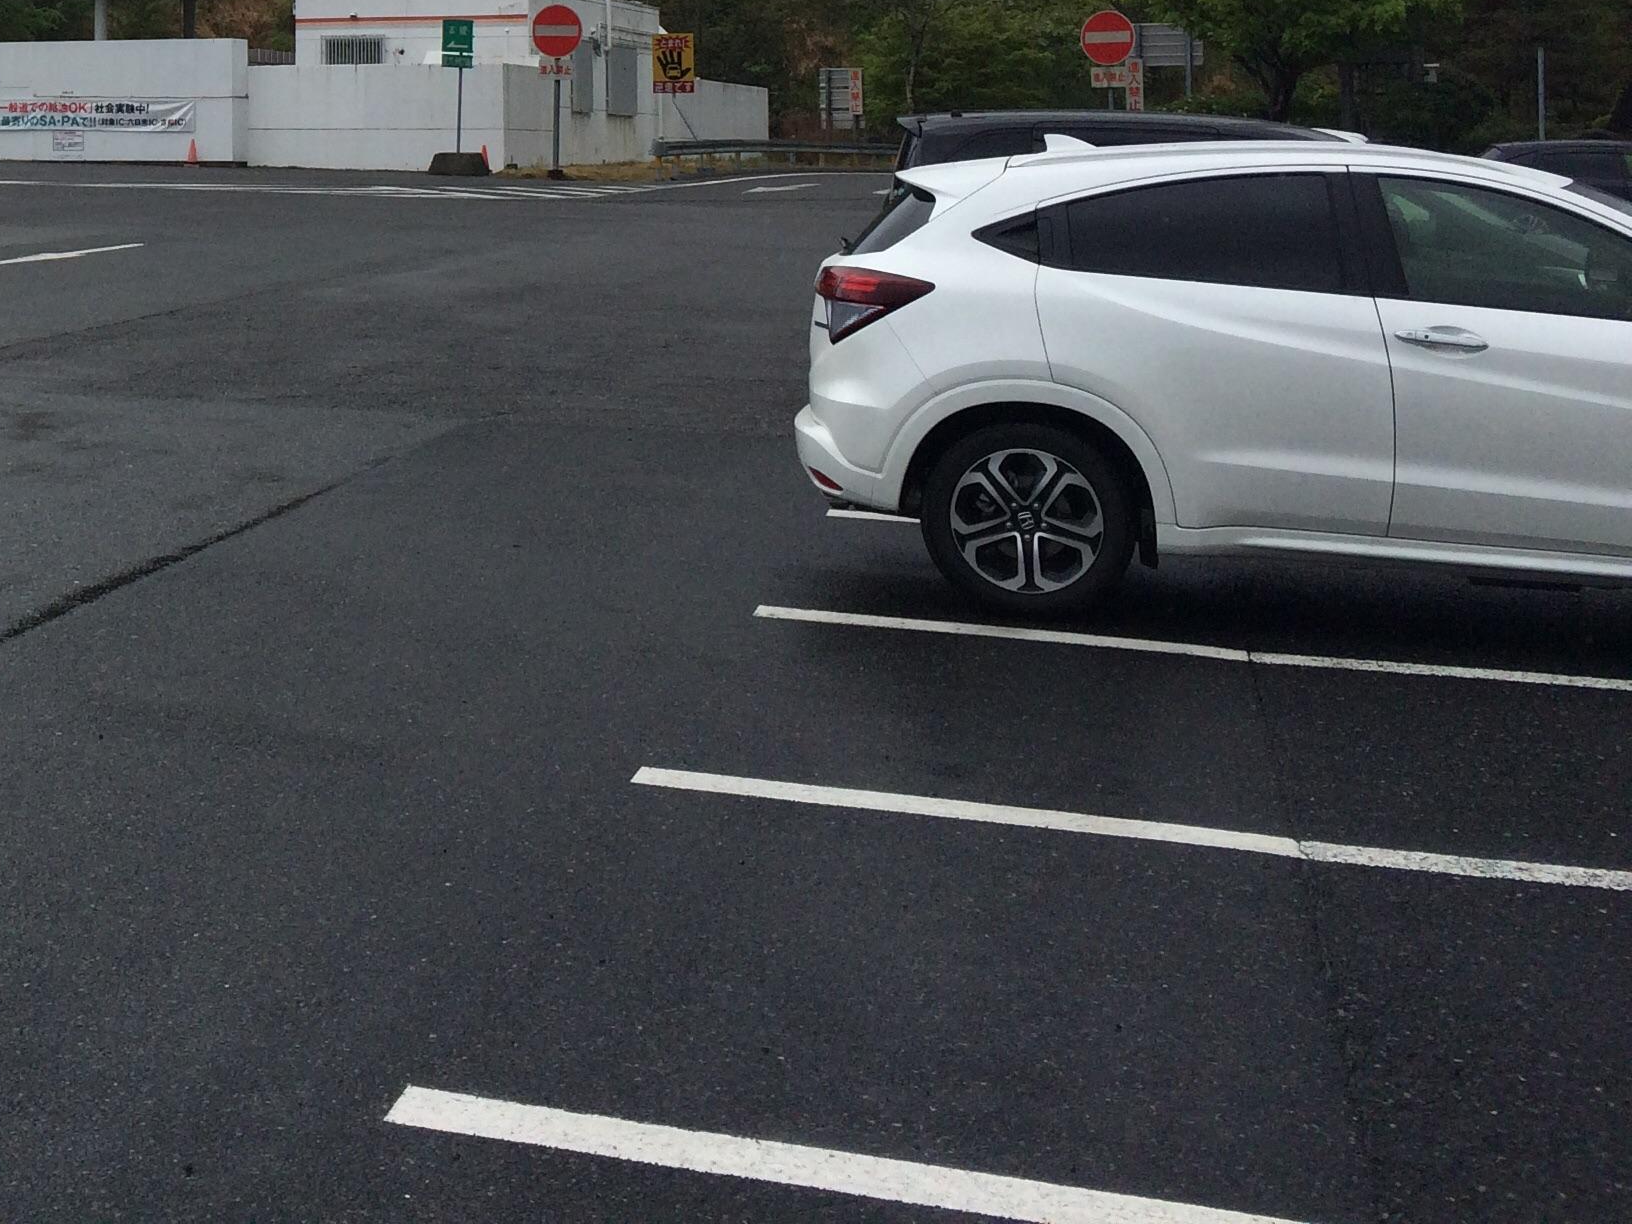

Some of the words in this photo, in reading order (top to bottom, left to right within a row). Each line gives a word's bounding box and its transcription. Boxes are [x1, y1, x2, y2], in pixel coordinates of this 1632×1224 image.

[540, 64, 572, 75] 進入禁止
[1128, 61, 1141, 111] 進入禁止
[850, 70, 861, 113] 進入禁止
